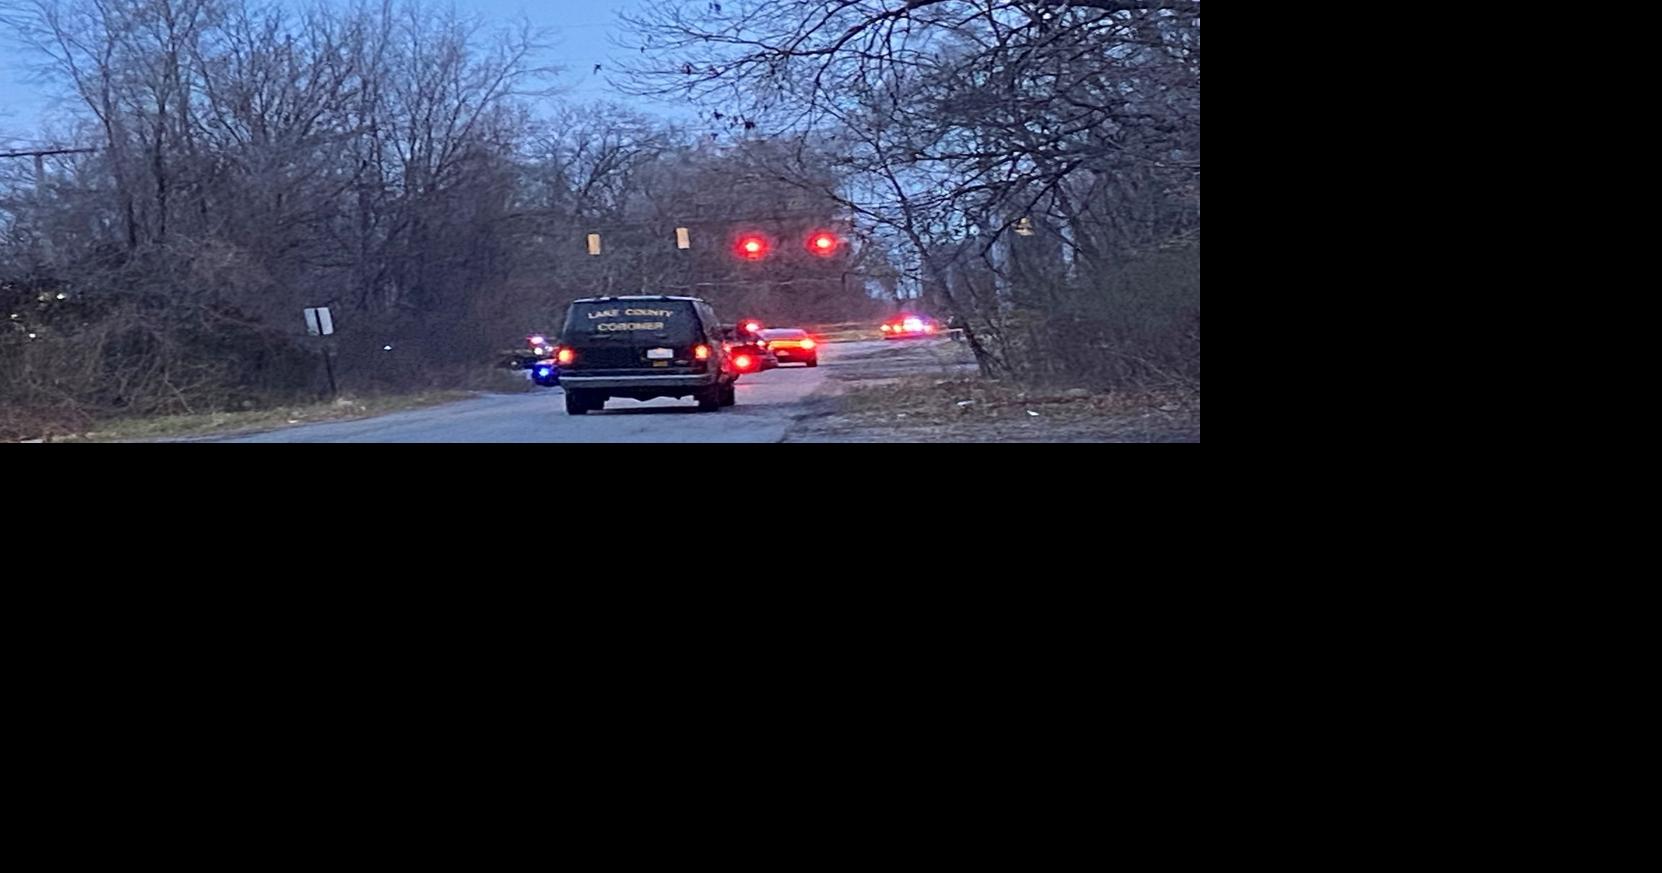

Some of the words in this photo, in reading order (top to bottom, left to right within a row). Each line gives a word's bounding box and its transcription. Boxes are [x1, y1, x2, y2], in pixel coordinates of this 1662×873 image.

[588, 309, 619, 319] LAKE
[624, 308, 673, 318] COUNTY
[597, 322, 664, 331] CORONER
